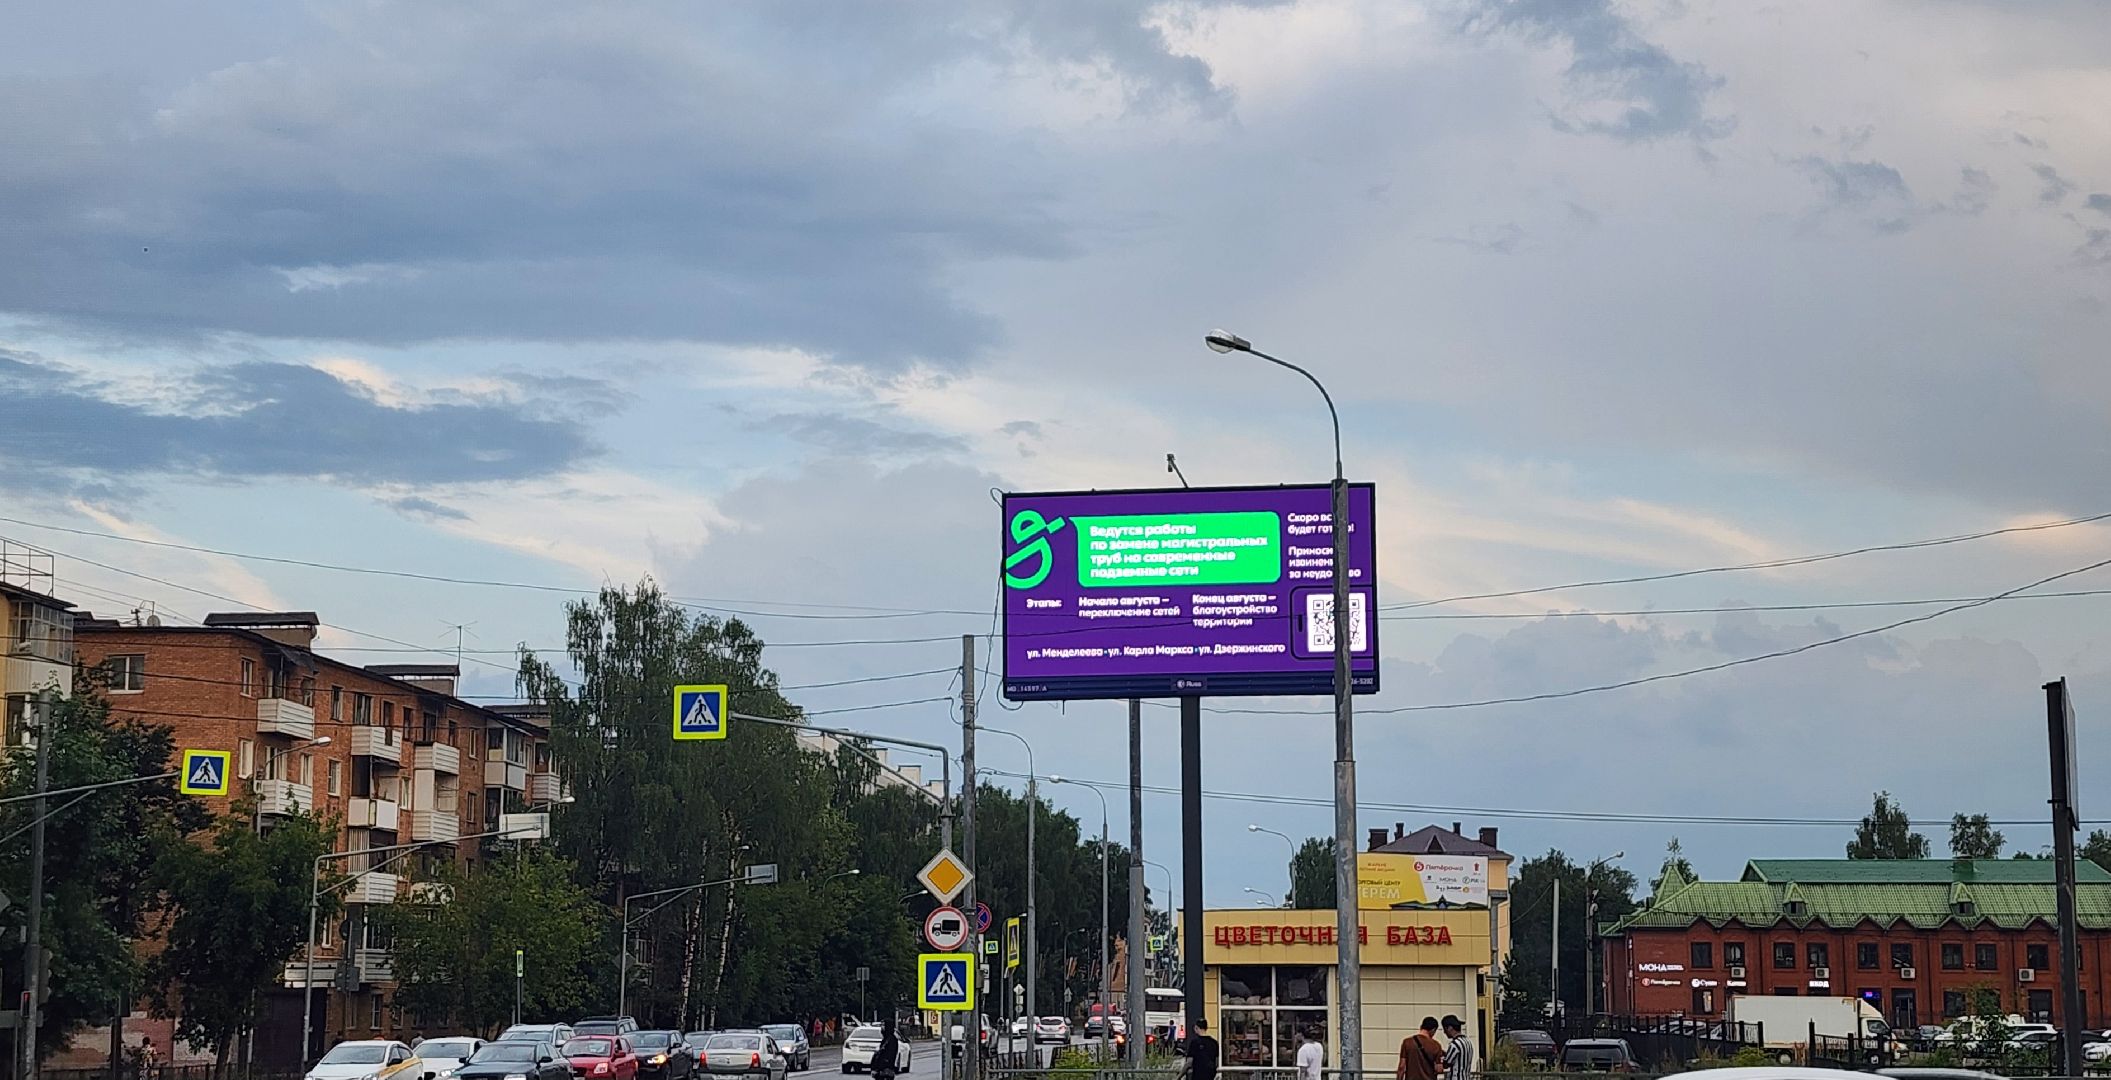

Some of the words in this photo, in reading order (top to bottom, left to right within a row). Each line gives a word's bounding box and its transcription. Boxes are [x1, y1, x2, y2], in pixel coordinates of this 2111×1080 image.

[1288, 513, 1319, 524] Скоро
[1090, 525, 1143, 538] Ведутся
[1145, 524, 1196, 537] работы
[1288, 525, 1316, 535] будет
[1090, 540, 1107, 550] по
[1109, 540, 1159, 549] замене
[1161, 537, 1268, 549] магистральных
[1288, 546, 1333, 557] Приноси
[1090, 552, 1122, 566] труб
[1124, 554, 1141, 563] на
[1143, 551, 1236, 564] современные
[1090, 567, 1167, 579] подземные
[1169, 566, 1199, 576] сети
[1288, 570, 1301, 578] за
[1303, 569, 1361, 579] неудово
[1027, 599, 1062, 608] Этапы:
[1079, 597, 1118, 606] Начало
[1120, 597, 1160, 607] августа
[1192, 594, 1225, 604] Конец
[1226, 594, 1267, 604] августа
[1079, 608, 1151, 619] переключение
[1152, 606, 1180, 616] сетей
[1192, 605, 1277, 616] благоустройство
[1193, 618, 1253, 628] территории
[1027, 650, 1041, 659] ул.
[1042, 648, 1103, 658] Менделеева
[1109, 648, 1122, 657] ул.
[1124, 646, 1152, 657] Карла
[1155, 645, 1193, 656] Маркса
[1199, 646, 1212, 656] ул.
[1214, 644, 1285, 655] Дзержинского
[1215, 926, 1368, 949] ЦВЕТОЧНЯ
[1387, 926, 1453, 945] БАЗА
[1638, 964, 1667, 972] МОНА
